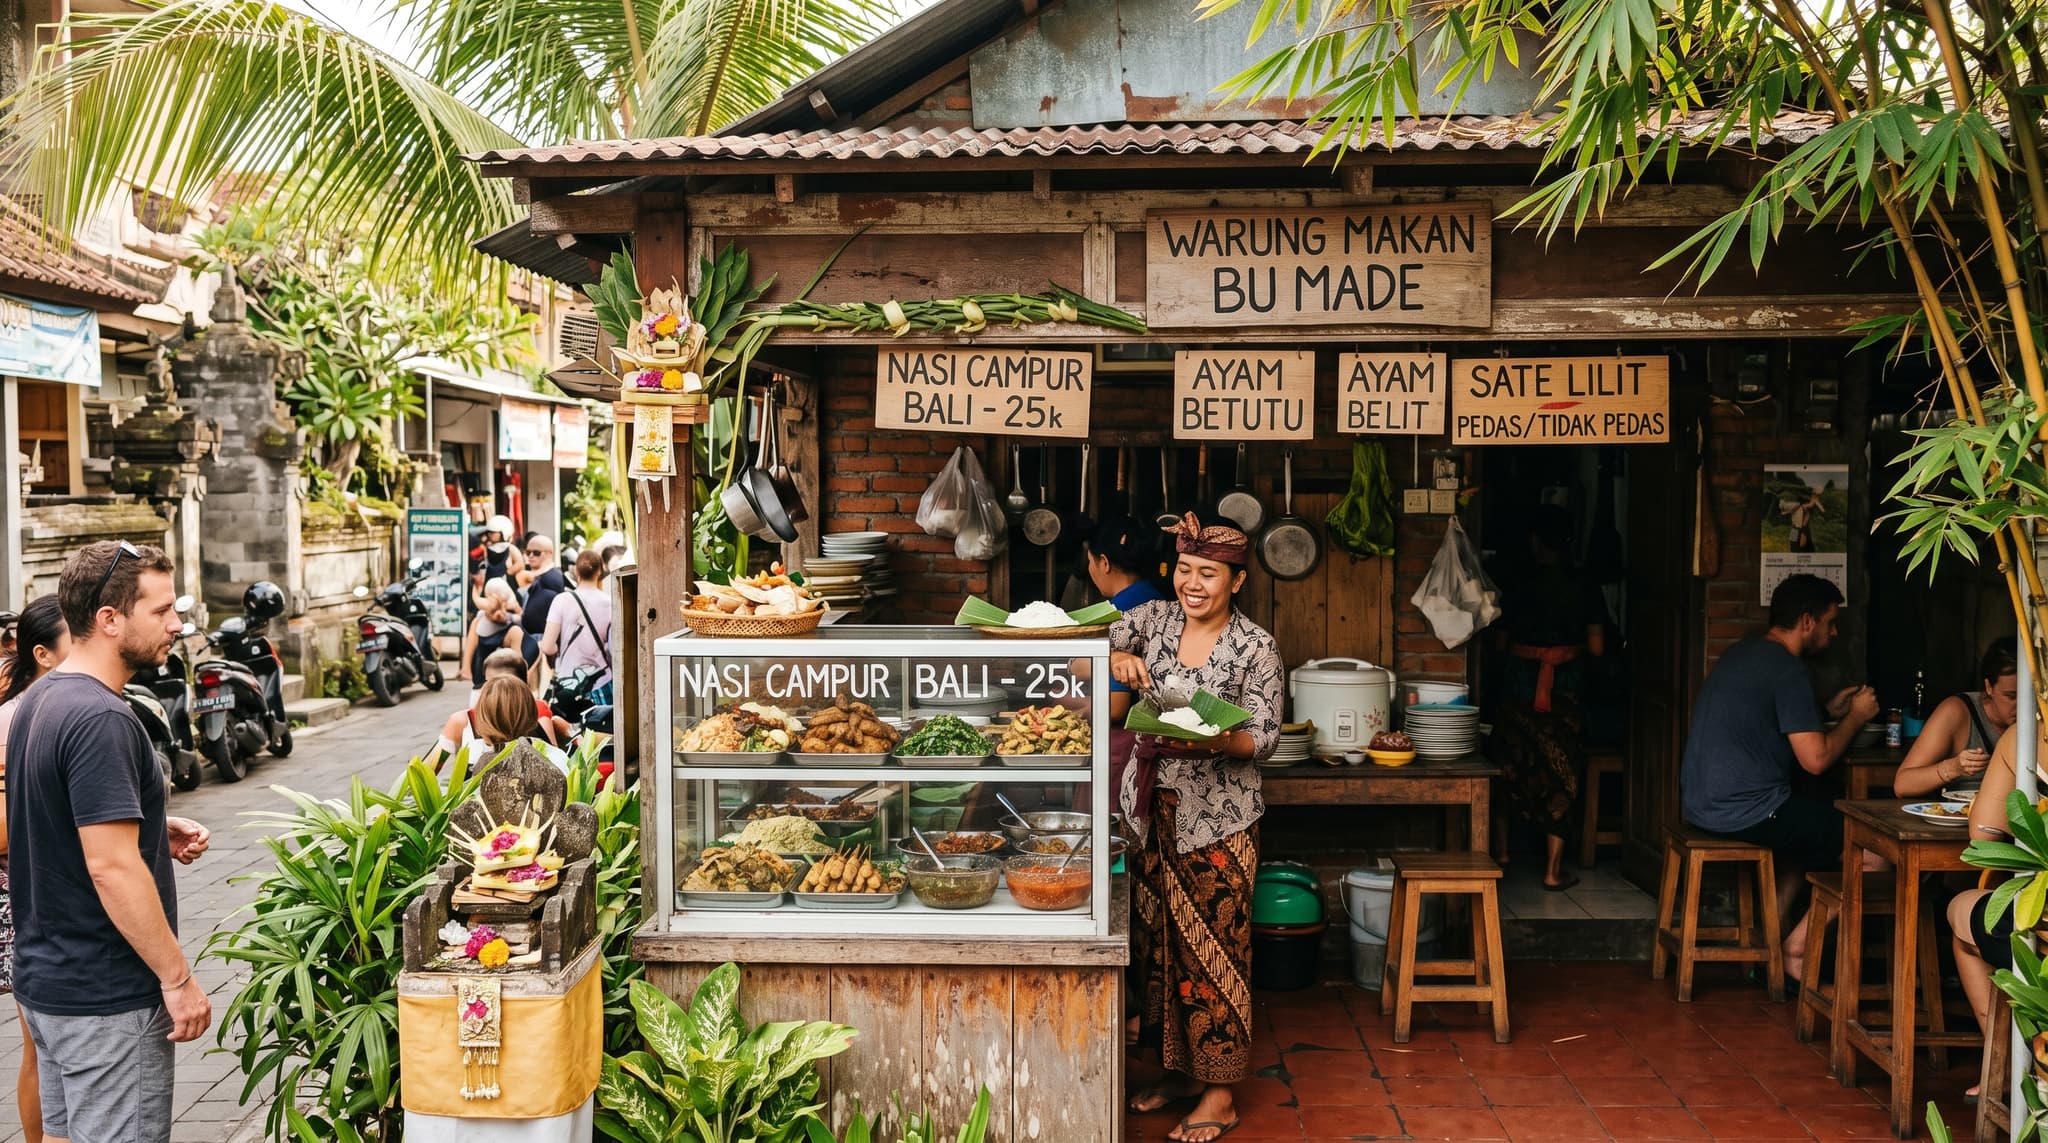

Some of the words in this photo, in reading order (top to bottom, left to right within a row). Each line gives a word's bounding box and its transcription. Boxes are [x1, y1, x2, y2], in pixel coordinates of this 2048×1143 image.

[1163, 216, 1327, 258] WARUNG
[1343, 214, 1475, 255] MAKAN
[1213, 265, 1276, 314] BU
[1295, 263, 1425, 312] MADE
[887, 351, 956, 386] NASI
[966, 354, 1084, 392] CAMPUR
[1191, 358, 1283, 392] AYAM
[1346, 360, 1435, 394] AYAM
[1469, 364, 1553, 398] SATE
[1568, 362, 1648, 397] LILIT
[904, 390, 972, 426] BALI
[1004, 394, 1063, 429] 25k
[1182, 397, 1304, 432] BETUTU
[1347, 399, 1430, 430] BELIT
[1457, 412, 1597, 439] PEDAS/TIDAK
[1603, 412, 1665, 436] PEDAS
[679, 663, 750, 698] NASI
[766, 663, 890, 699] CAMPUR
[916, 664, 989, 699] BALI
[1025, 663, 1086, 699] 25k
